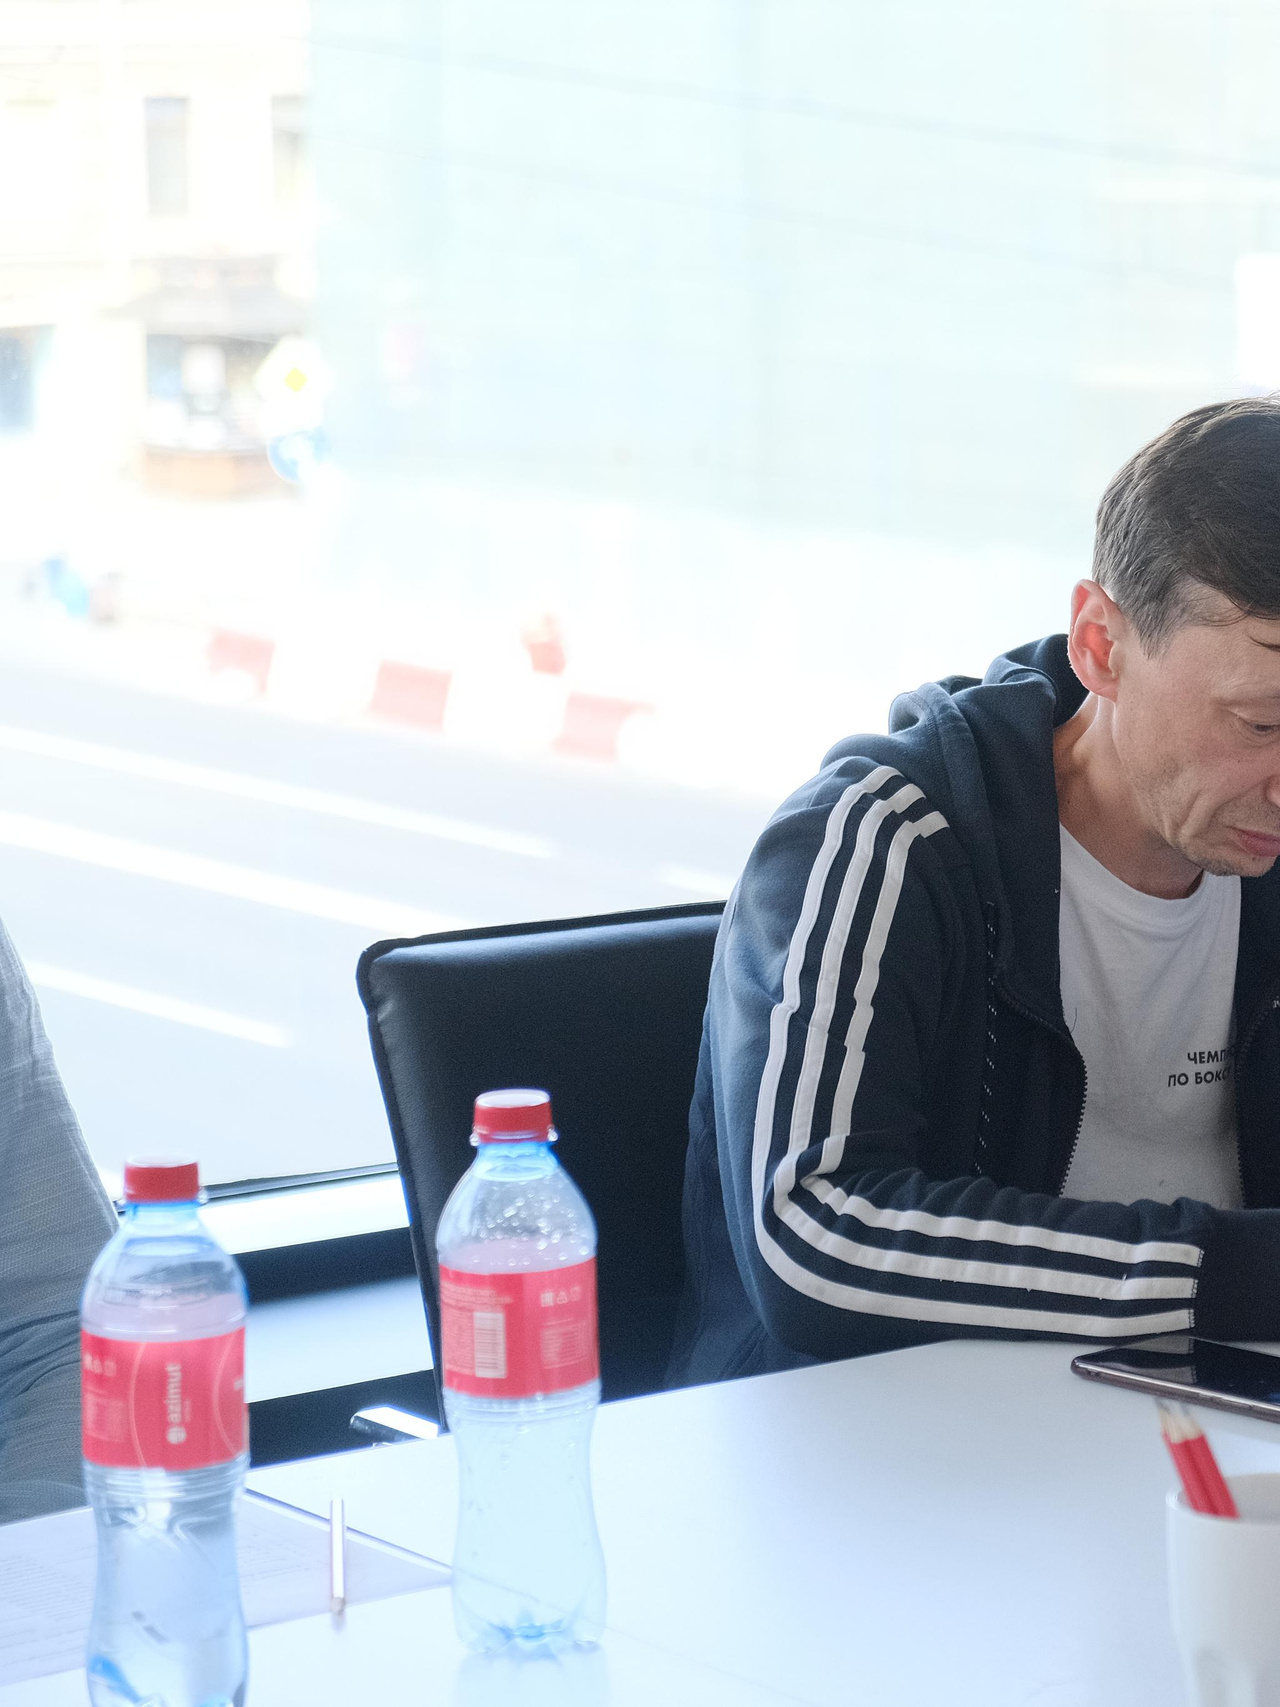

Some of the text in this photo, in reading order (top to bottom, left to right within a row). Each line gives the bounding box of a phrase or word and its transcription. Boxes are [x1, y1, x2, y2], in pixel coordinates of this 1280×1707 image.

[1187, 1050, 1227, 1065] ЧЕМП
[1168, 1067, 1230, 1087] ПО БОКС
